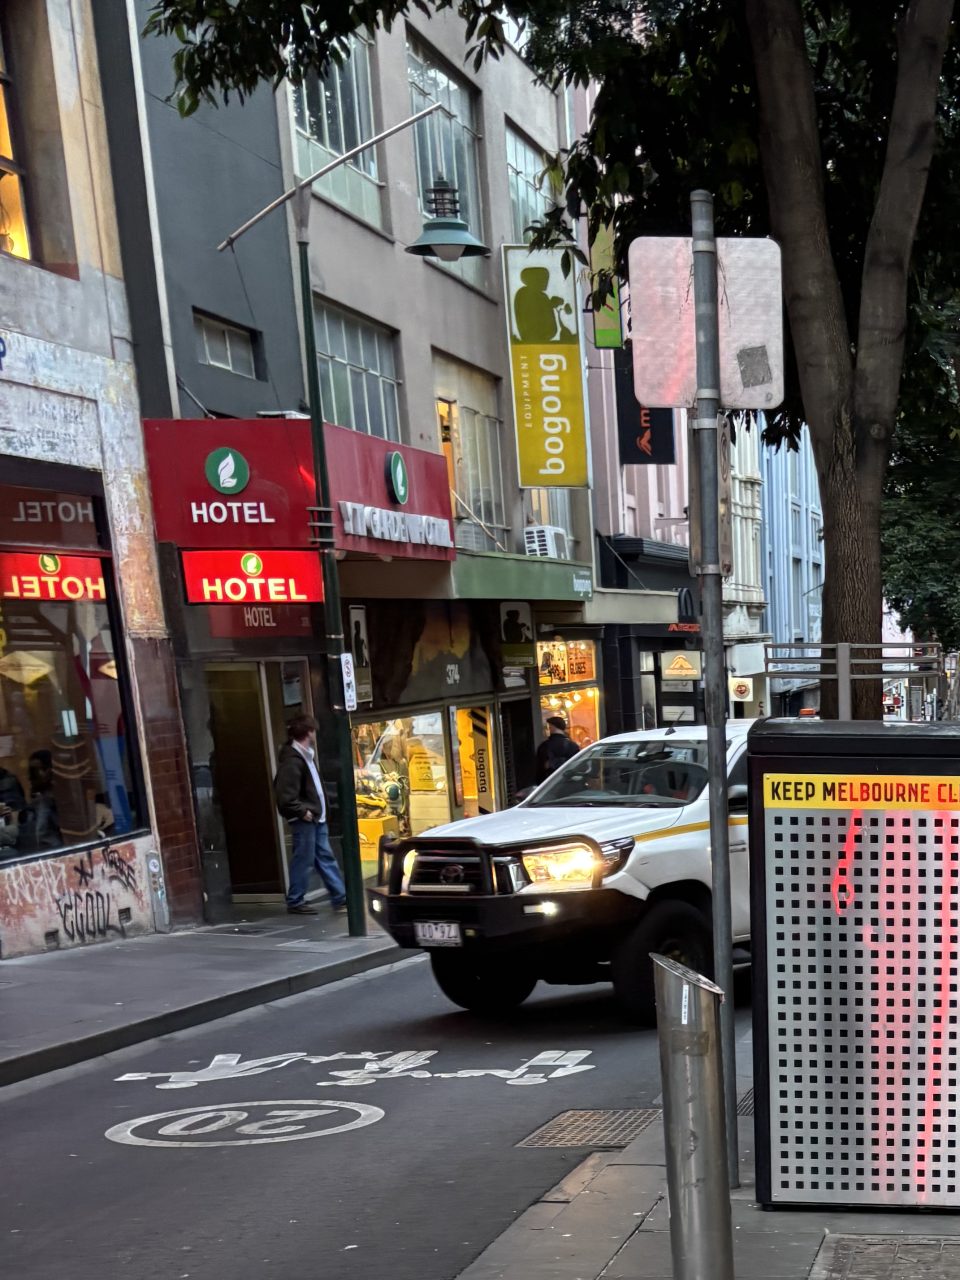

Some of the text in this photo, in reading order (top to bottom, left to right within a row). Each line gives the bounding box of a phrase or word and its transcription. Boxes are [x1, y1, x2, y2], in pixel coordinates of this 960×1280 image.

[520, 355, 533, 428] EQUIPMENT
[538, 353, 571, 475] bogong
[190, 502, 276, 524] HOTEL
[202, 577, 308, 601] HOTEL
[243, 607, 277, 627] HOTEL
[771, 781, 815, 801] KEEP
[822, 782, 930, 803] MELBOURNE
[158, 1109, 340, 1136] 20
